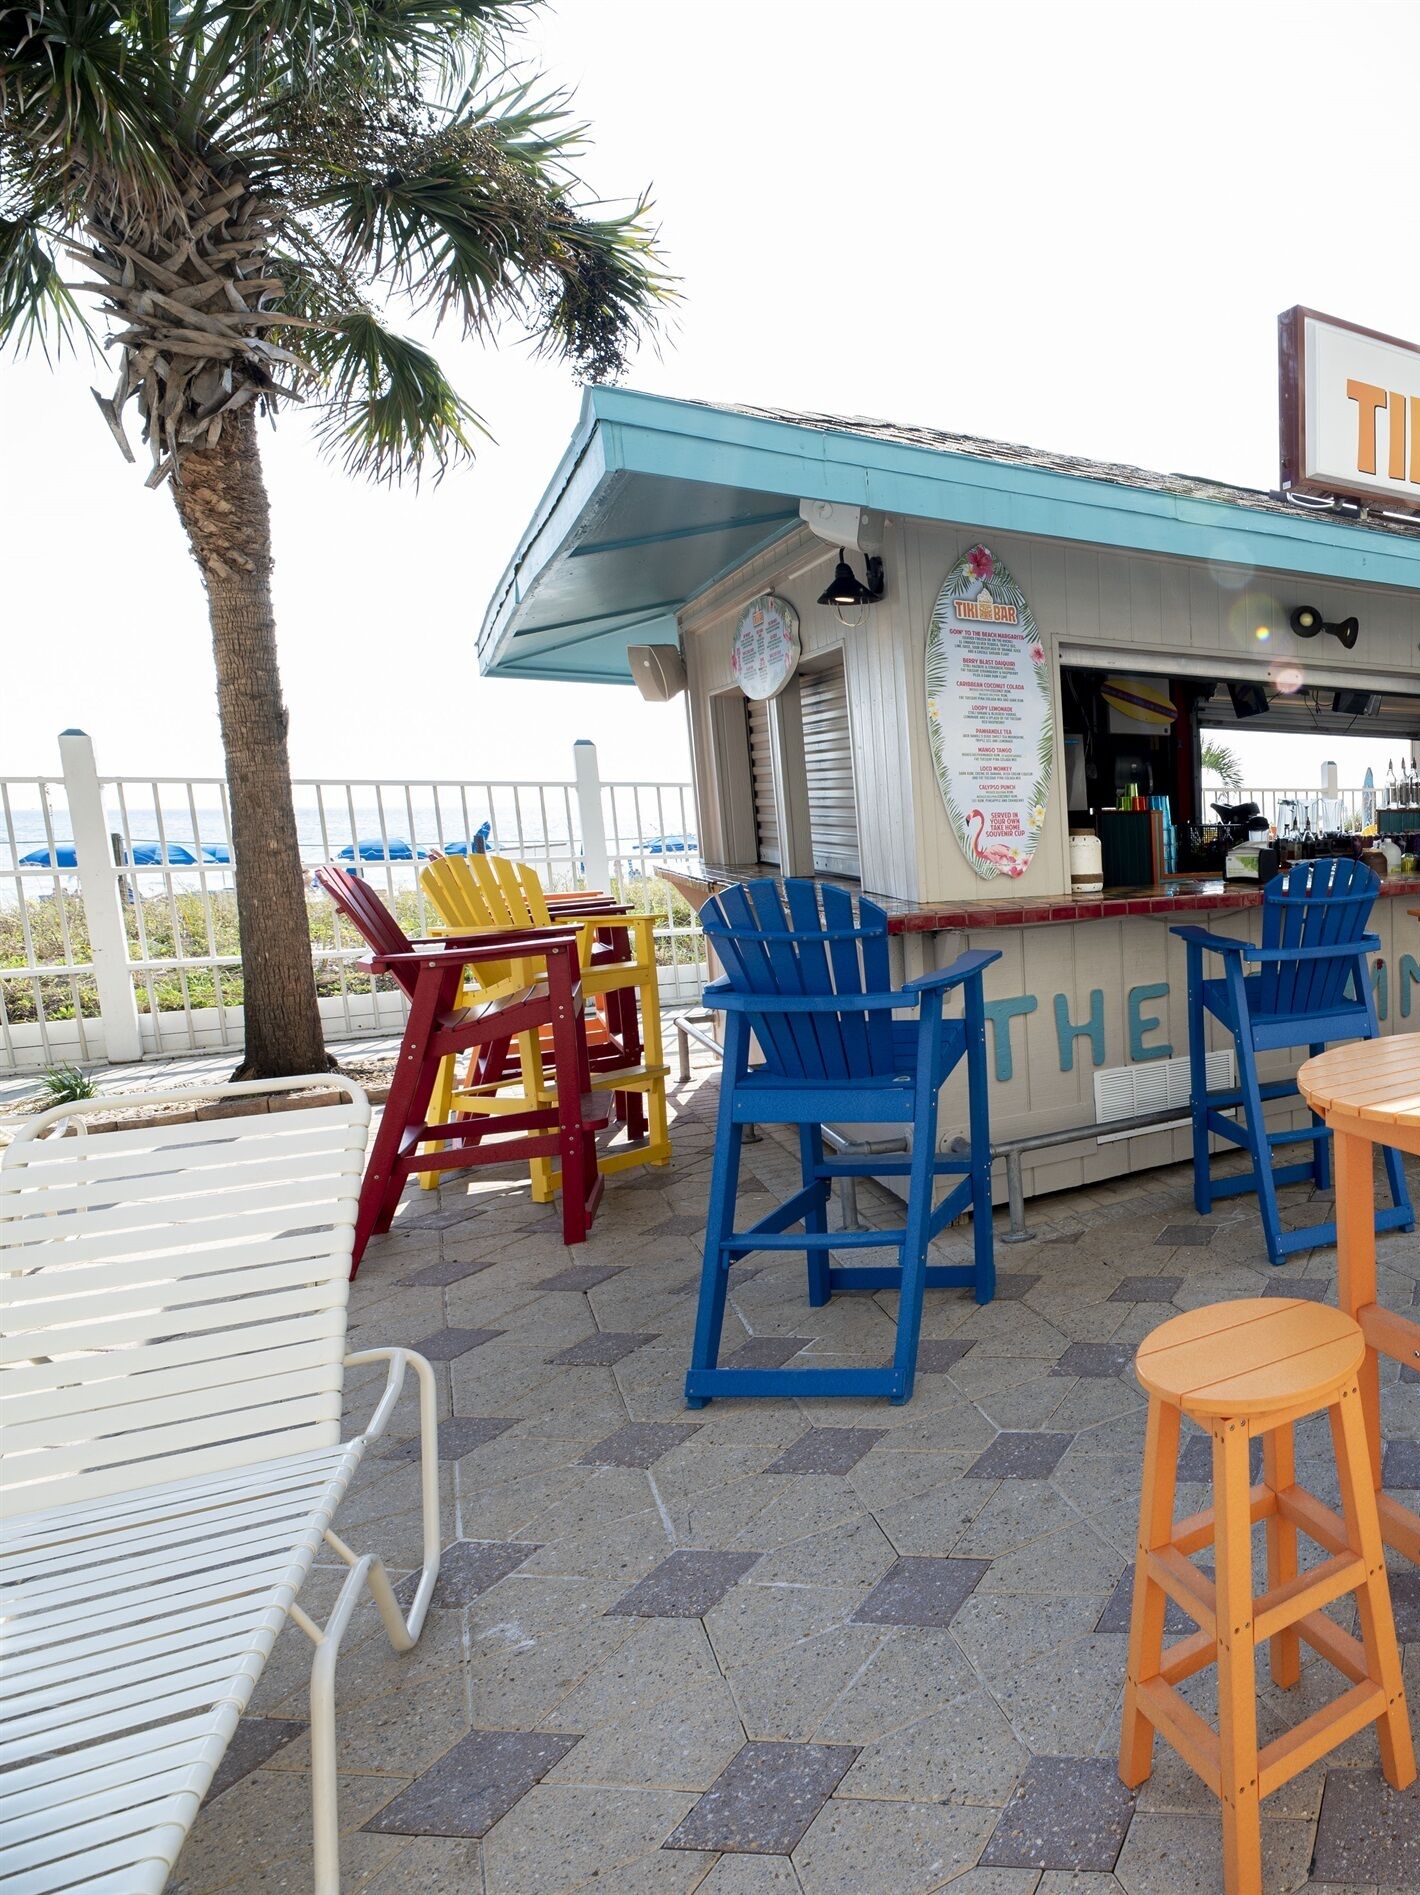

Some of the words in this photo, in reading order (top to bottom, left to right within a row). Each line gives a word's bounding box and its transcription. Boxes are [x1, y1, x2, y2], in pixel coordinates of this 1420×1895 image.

[955, 601, 978, 619] TIKI
[994, 604, 1016, 623] BAR
[997, 632, 1025, 640] MARGARITA
[984, 982, 1173, 1082] THE
